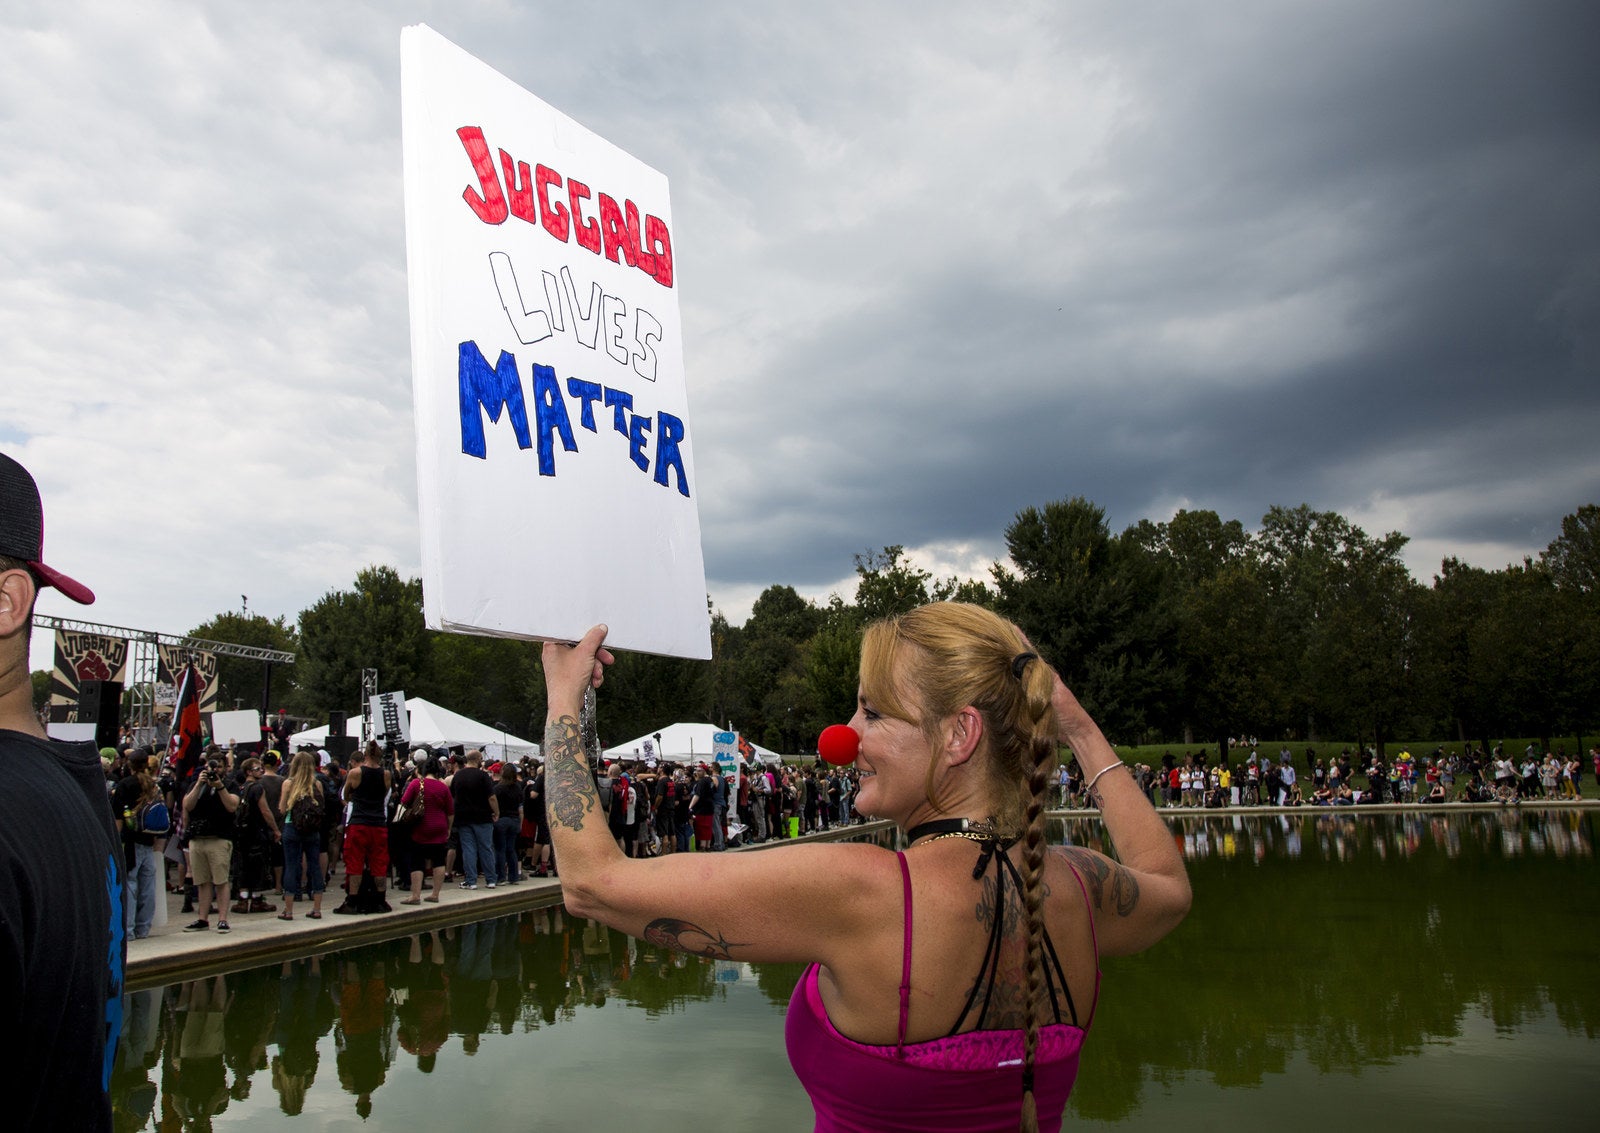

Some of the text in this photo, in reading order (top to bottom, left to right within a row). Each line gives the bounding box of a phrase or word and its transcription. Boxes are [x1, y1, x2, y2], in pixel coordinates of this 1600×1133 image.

[456, 126, 674, 288] JUGGALO
[489, 252, 663, 382] LIVES
[458, 340, 691, 497] MATTER
[64, 635, 124, 665] JUGGALO
[166, 649, 216, 677] JUGALO
